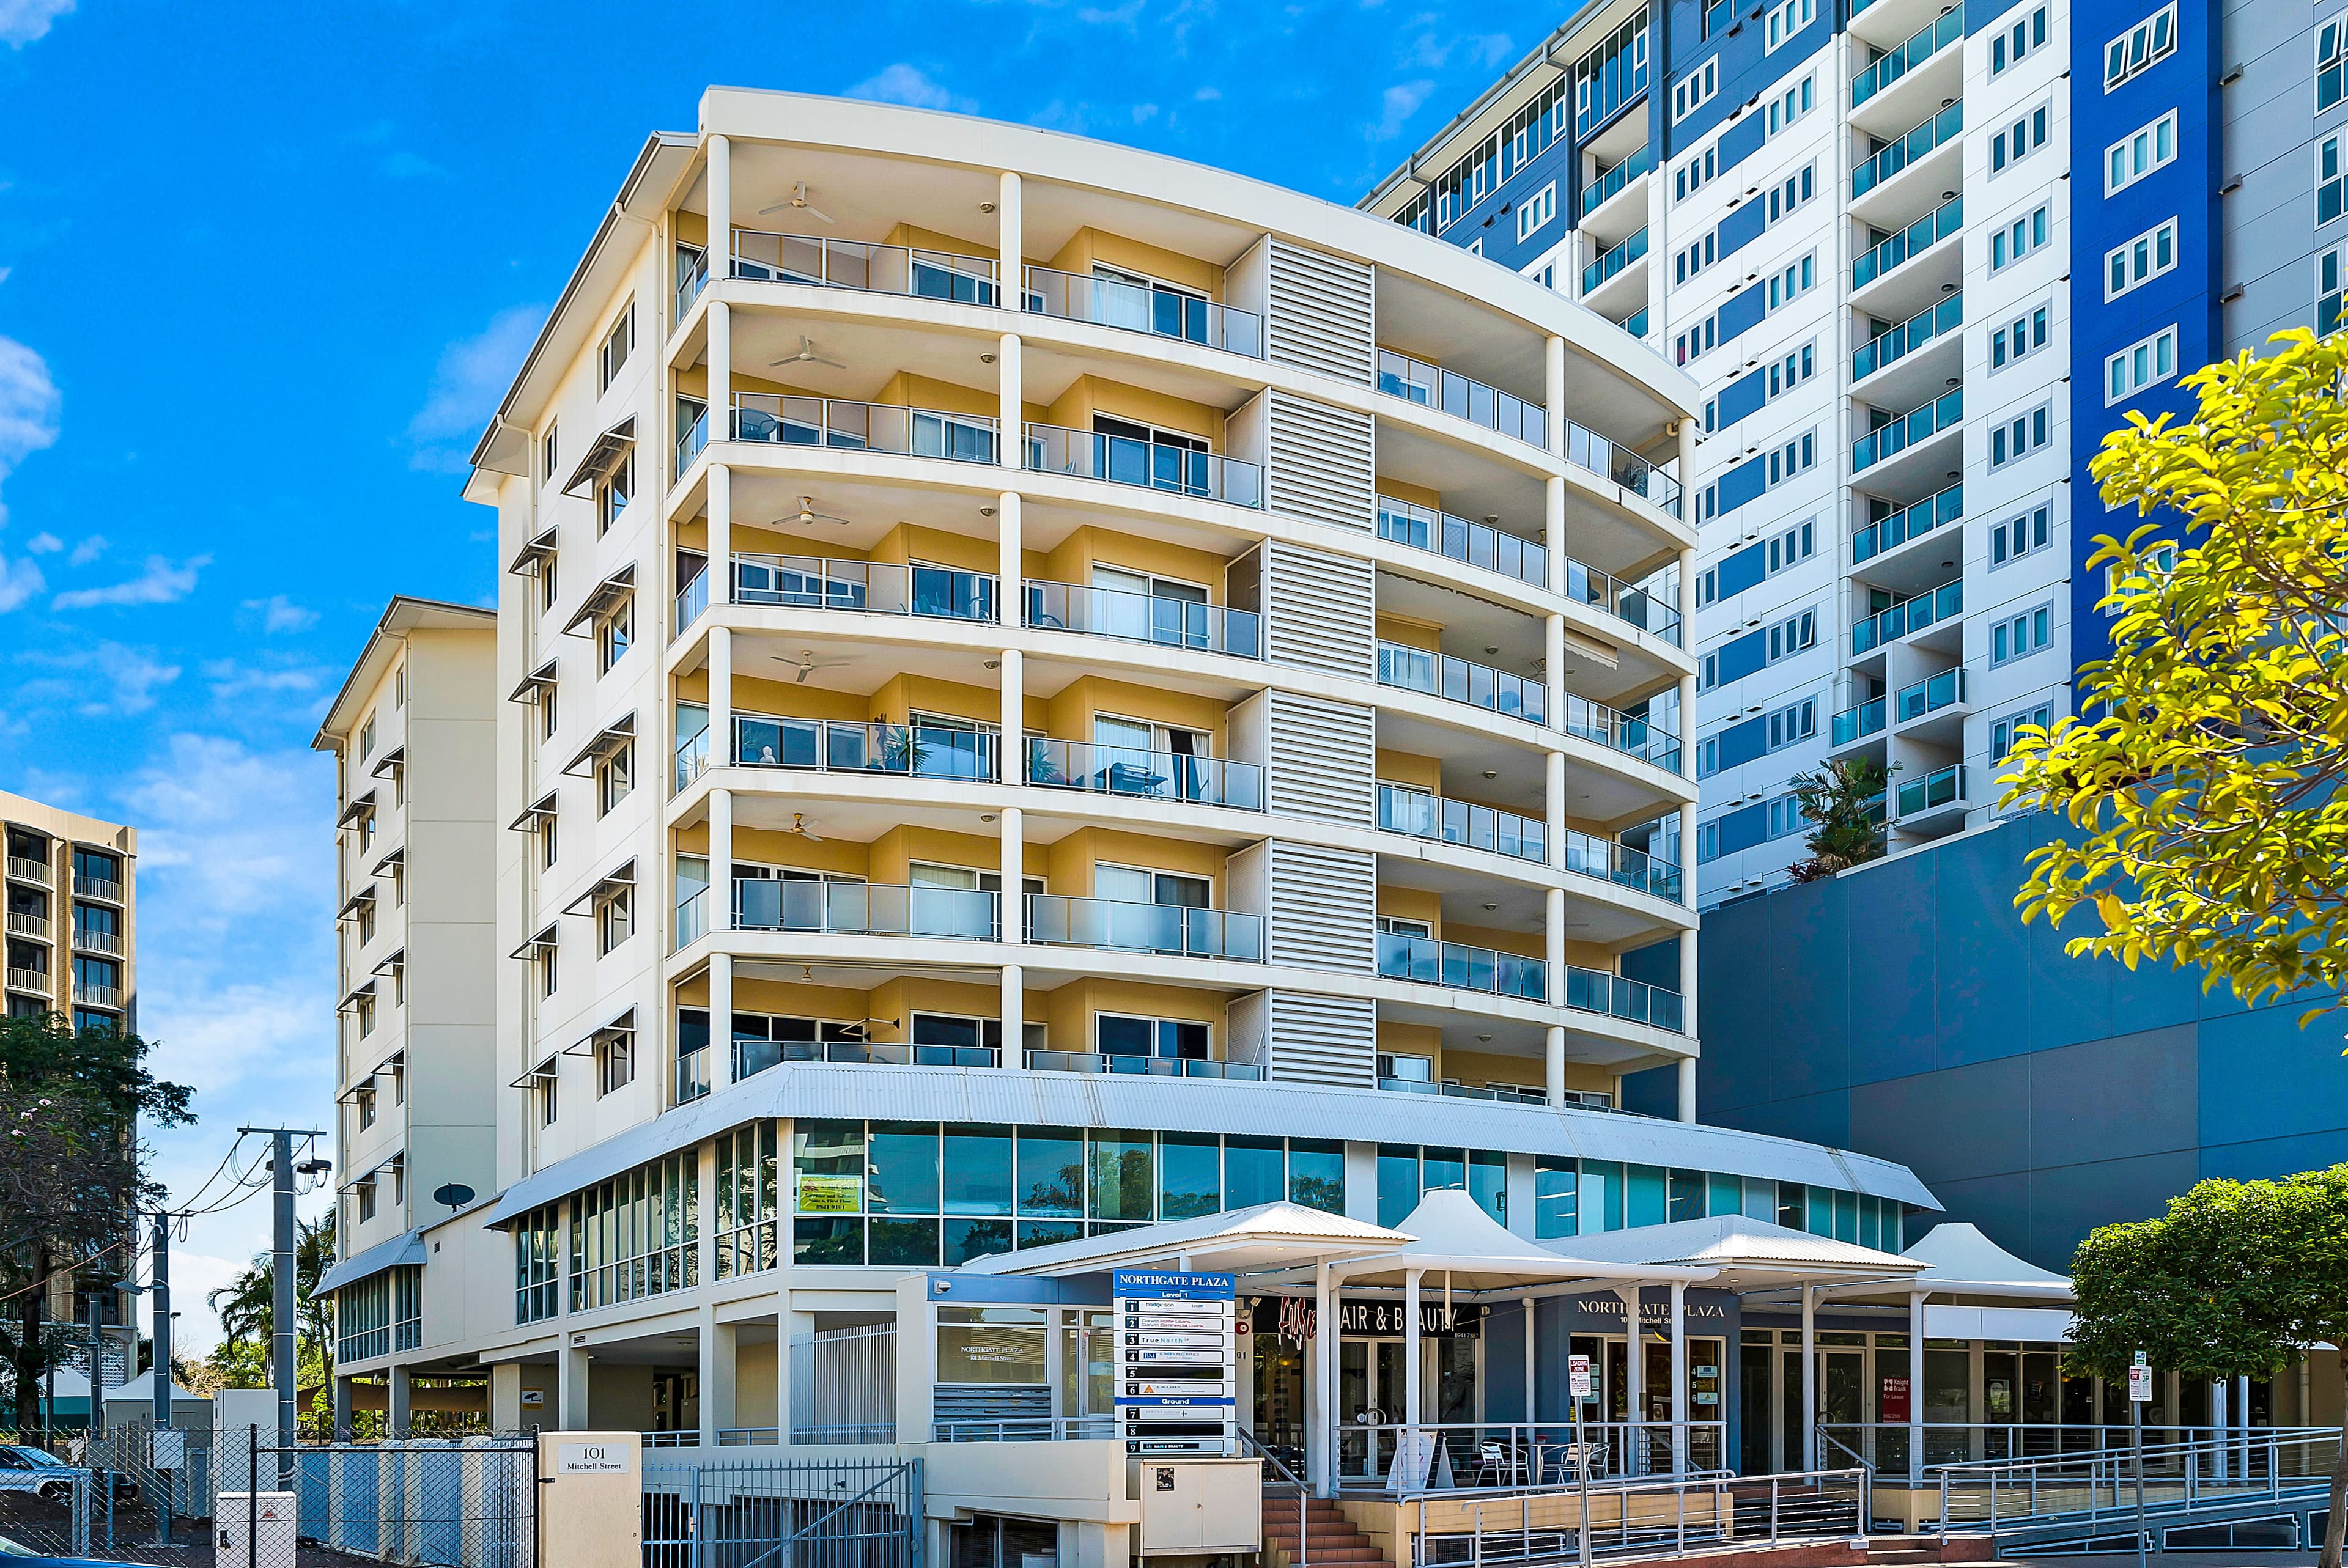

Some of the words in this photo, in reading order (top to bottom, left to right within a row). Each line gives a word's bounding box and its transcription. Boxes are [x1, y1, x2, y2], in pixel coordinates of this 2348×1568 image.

[1120, 1275, 1188, 1286] NORTHGATE
[1192, 1277, 1229, 1287] PLAZA
[1340, 1305, 1367, 1330] AIR
[1376, 1306, 1387, 1330] &
[1395, 1307, 1457, 1332] BAUTY
[583, 1447, 605, 1459] 101
